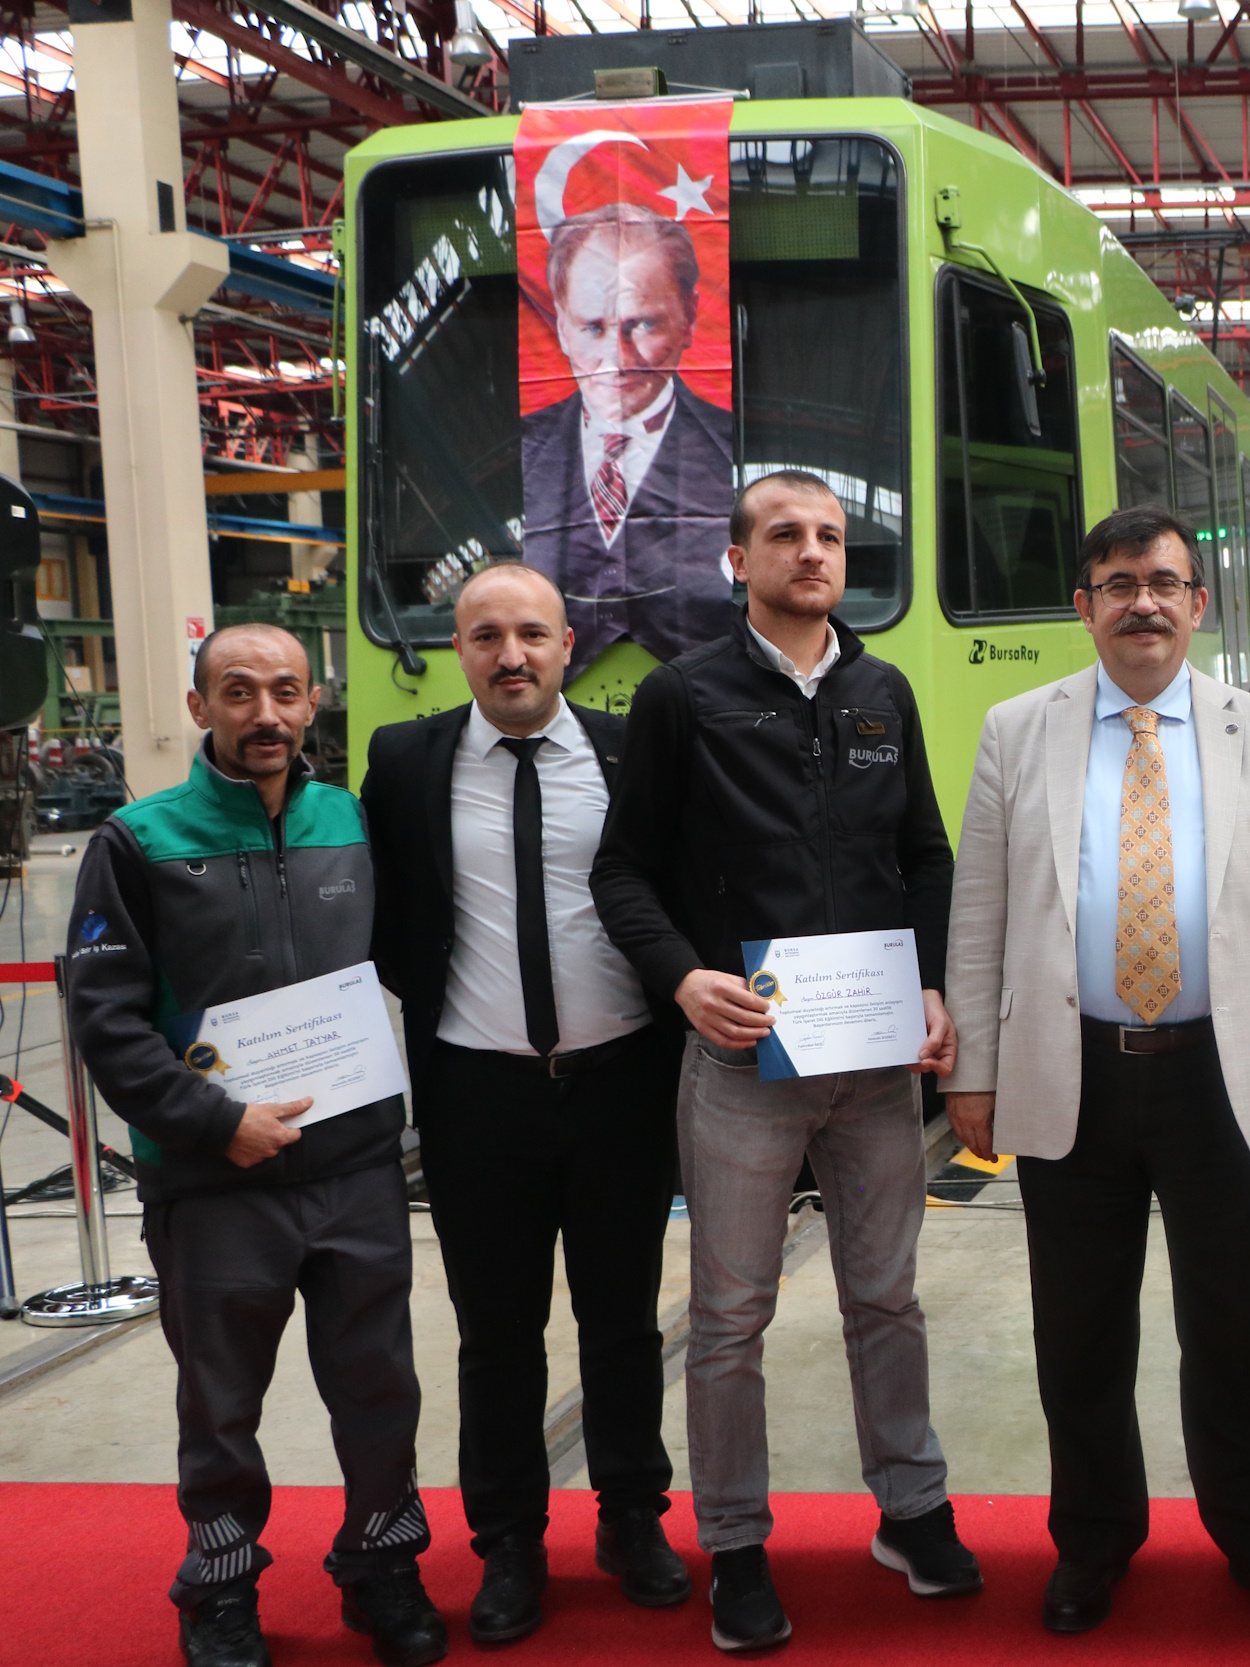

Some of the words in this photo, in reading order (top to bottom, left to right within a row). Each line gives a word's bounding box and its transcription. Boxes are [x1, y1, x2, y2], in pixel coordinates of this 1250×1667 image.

[990, 644, 1039, 665] BursaRay
[848, 748, 899, 766] BURULAŞ
[319, 883, 356, 896] BURULAŞ
[795, 973, 832, 984] Katılım
[836, 969, 884, 981] Sertifikası
[238, 1031, 282, 1049] Katılım
[286, 1013, 342, 1034] Sertifikası
